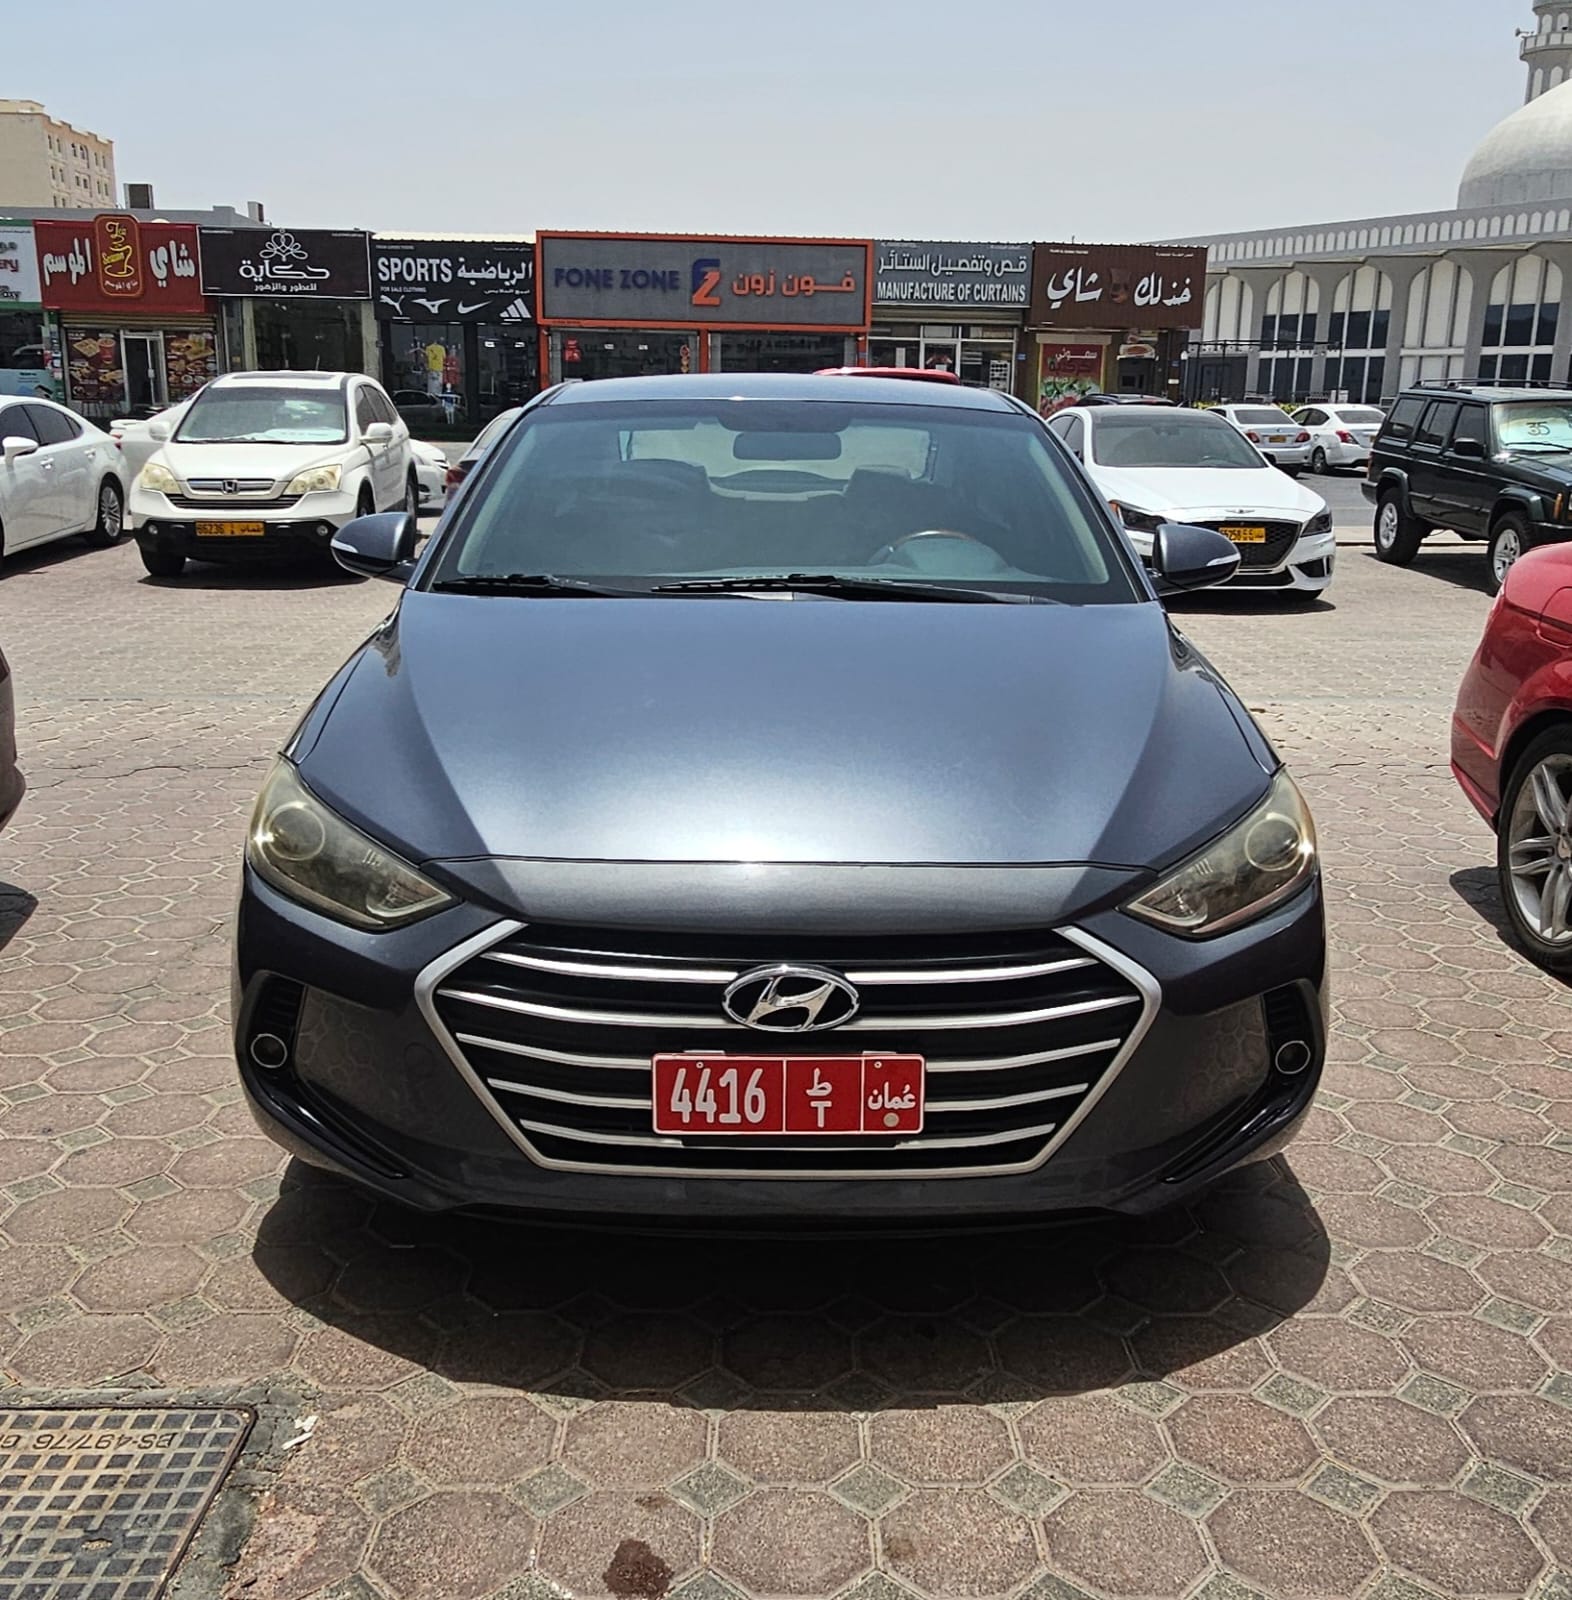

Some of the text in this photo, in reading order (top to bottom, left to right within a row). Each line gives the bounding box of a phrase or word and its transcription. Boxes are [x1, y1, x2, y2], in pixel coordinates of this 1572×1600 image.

[43, 237, 195, 288] شاي الموسم
[239, 259, 331, 282] حكاية
[377, 256, 453, 283] SPORTS
[456, 256, 533, 286] الرياضية
[878, 249, 1027, 277] قص وتفصيل الستائر
[554, 267, 680, 293] FONE ZONE
[732, 268, 856, 297] فون زون
[877, 281, 1026, 303] MANUFACTURE OF CURTAINS
[1047, 265, 1103, 310] شاي
[1526, 421, 1551, 437] 35
[670, 1067, 766, 1124] 4416
[806, 1067, 833, 1096] ط
[810, 1100, 833, 1128] T
[32, 1432, 179, 1450] BS-497/76
